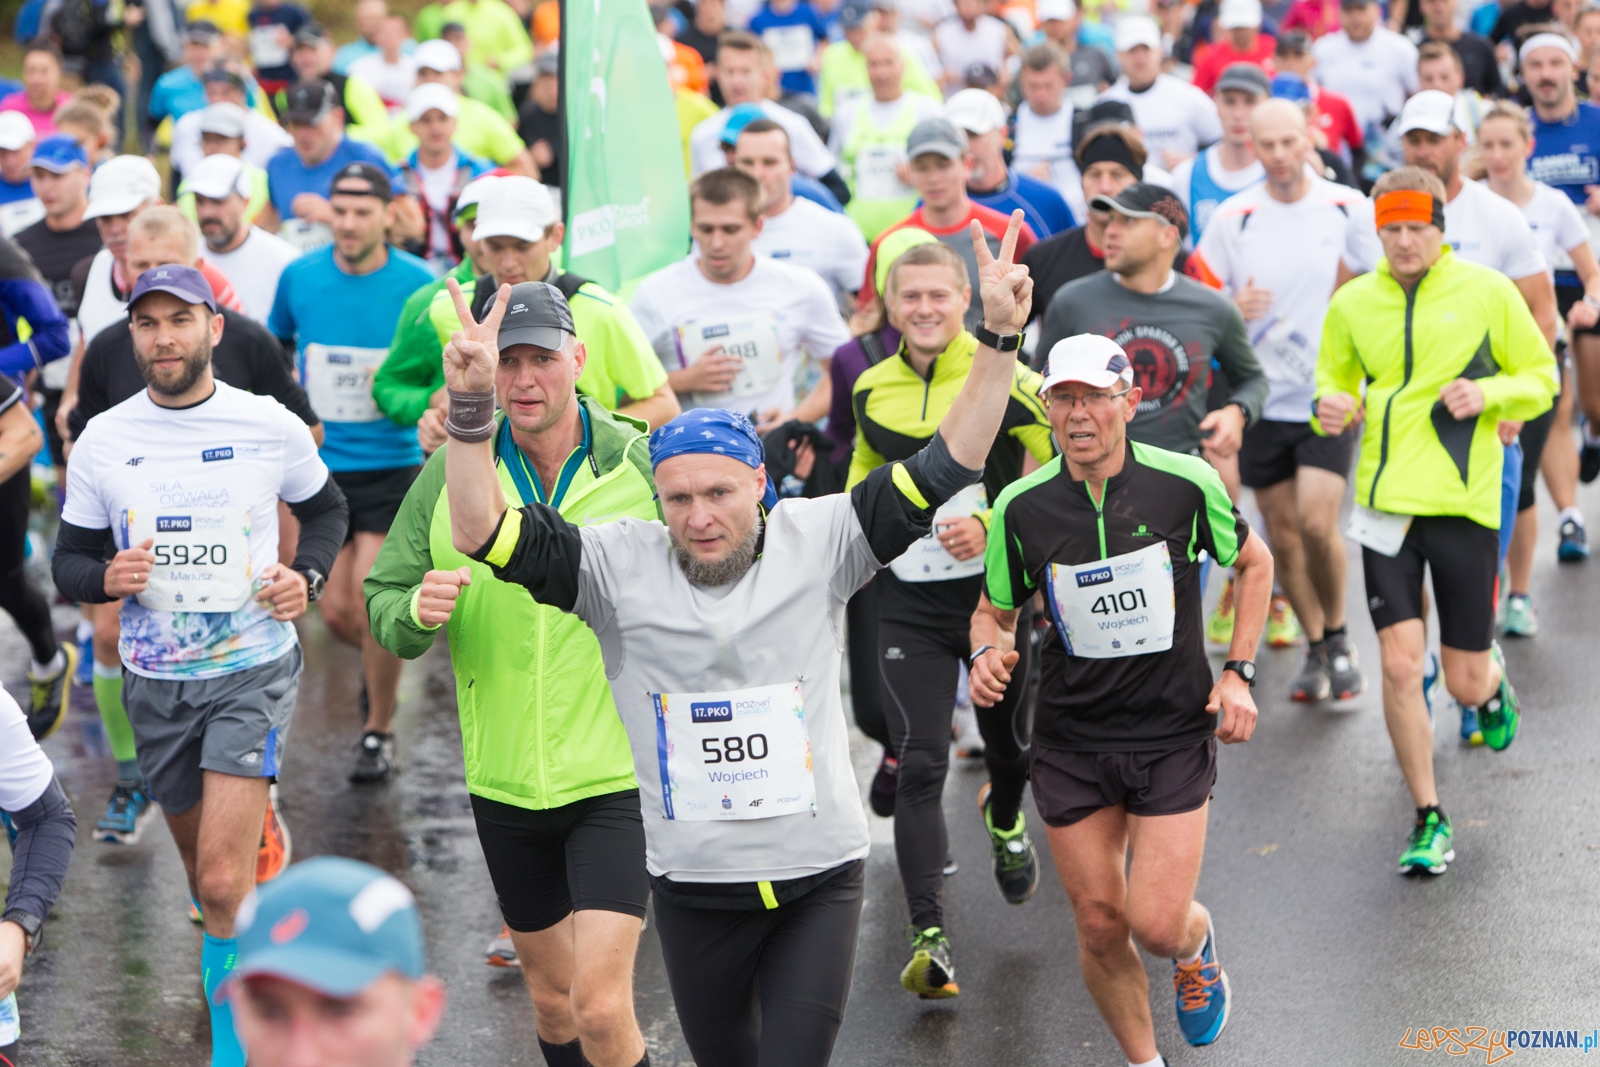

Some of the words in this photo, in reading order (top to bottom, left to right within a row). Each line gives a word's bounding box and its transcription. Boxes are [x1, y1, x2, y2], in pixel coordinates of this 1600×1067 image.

[577, 217, 612, 241] PKO
[204, 449, 232, 461] 17.PKO
[149, 480, 183, 494] SIŁA
[159, 487, 231, 505] ODWAGA
[159, 519, 190, 530] 17.PKO
[154, 544, 228, 566] 5920
[170, 570, 213, 581] Mariusz
[1078, 570, 1111, 584] 17.PKO
[1091, 588, 1148, 616] 4101
[1097, 614, 1149, 631] Wojciech
[693, 706, 730, 718] 17.PKO
[735, 696, 772, 710] POZnań
[736, 705, 772, 717] maraton
[702, 733, 769, 764] 580
[708, 768, 769, 785] Wojciech
[749, 798, 764, 808] 4F
